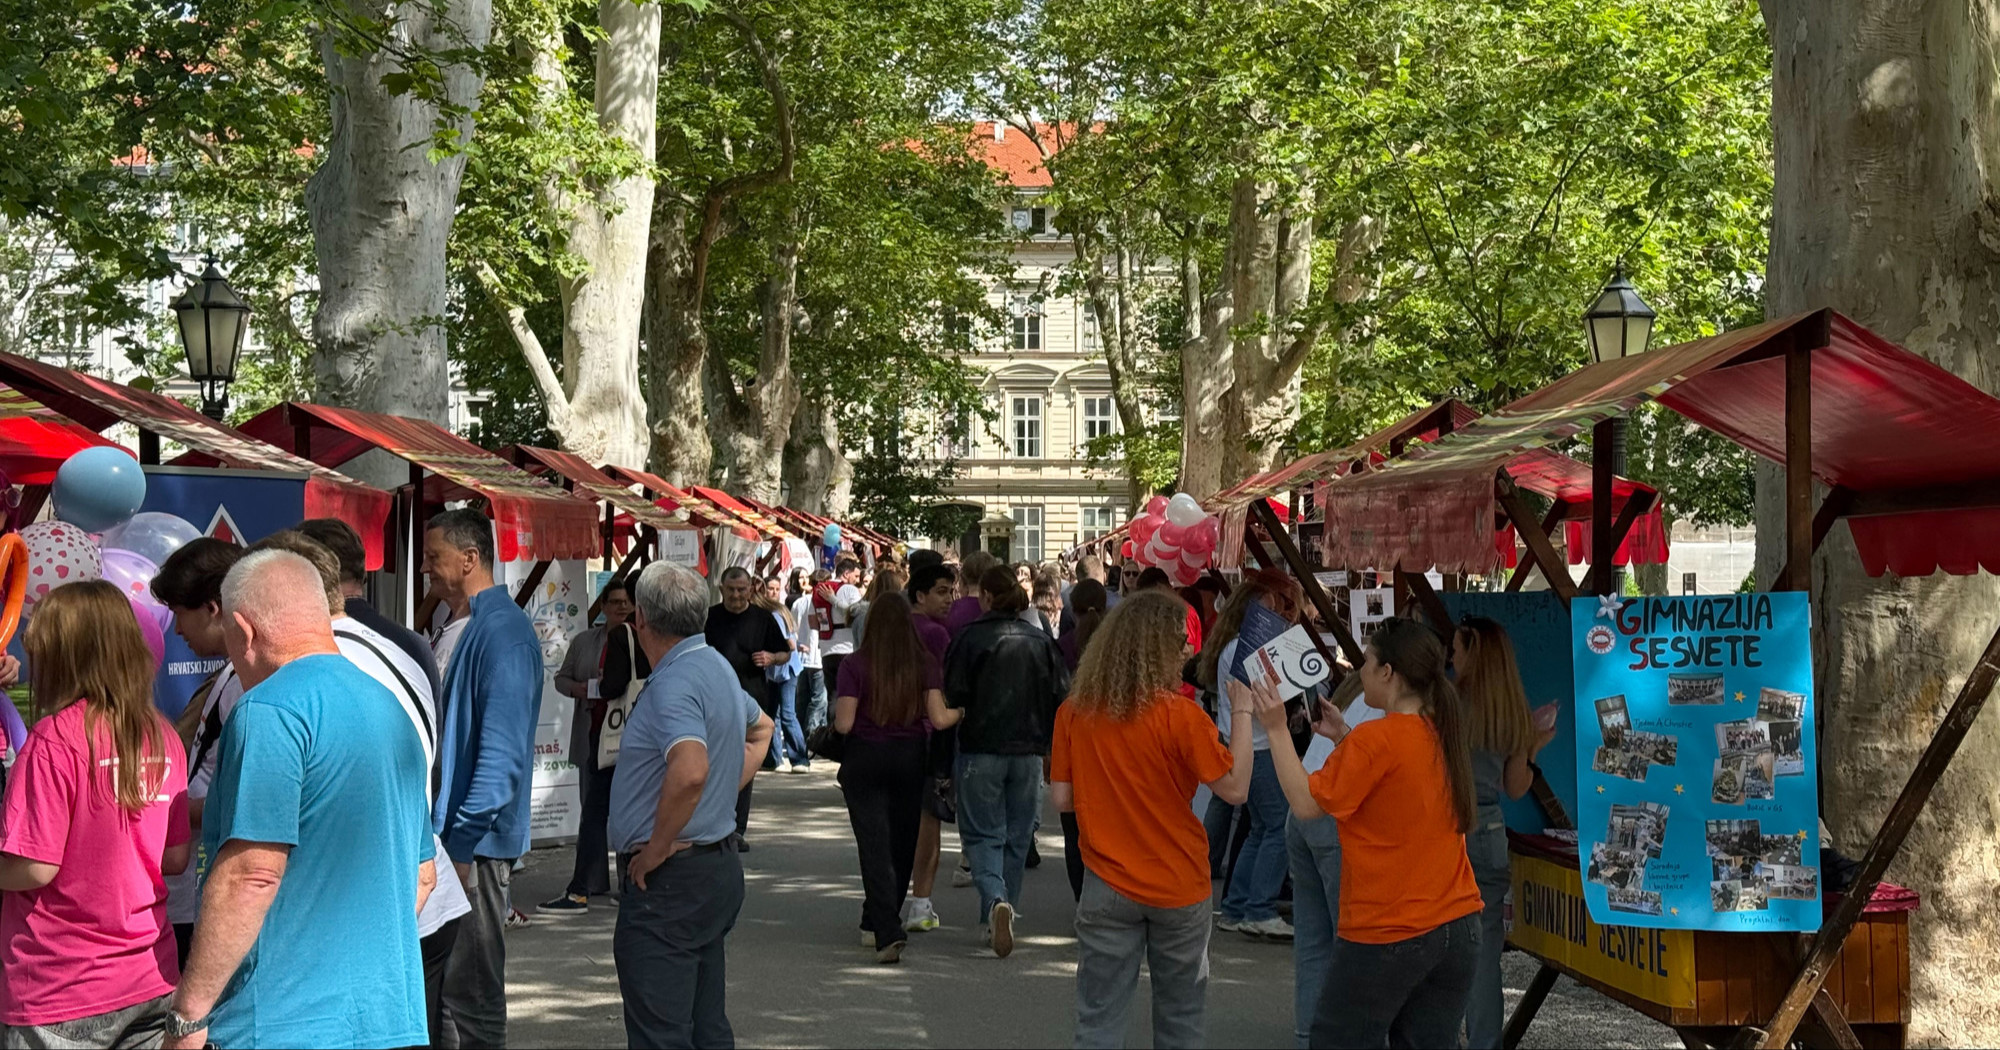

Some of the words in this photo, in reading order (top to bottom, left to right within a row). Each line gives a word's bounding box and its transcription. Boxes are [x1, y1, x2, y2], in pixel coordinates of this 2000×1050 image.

[1616, 595, 1772, 635] GIMNAZIJA
[168, 661, 202, 676] HRVATSKI
[1266, 645, 1279, 664] IX.
[1629, 635, 1762, 671] SESVETE
[533, 738, 563, 755] naš,
[1523, 881, 1587, 946] GIMNAZIJA
[1600, 925, 1668, 977] SESVETE
